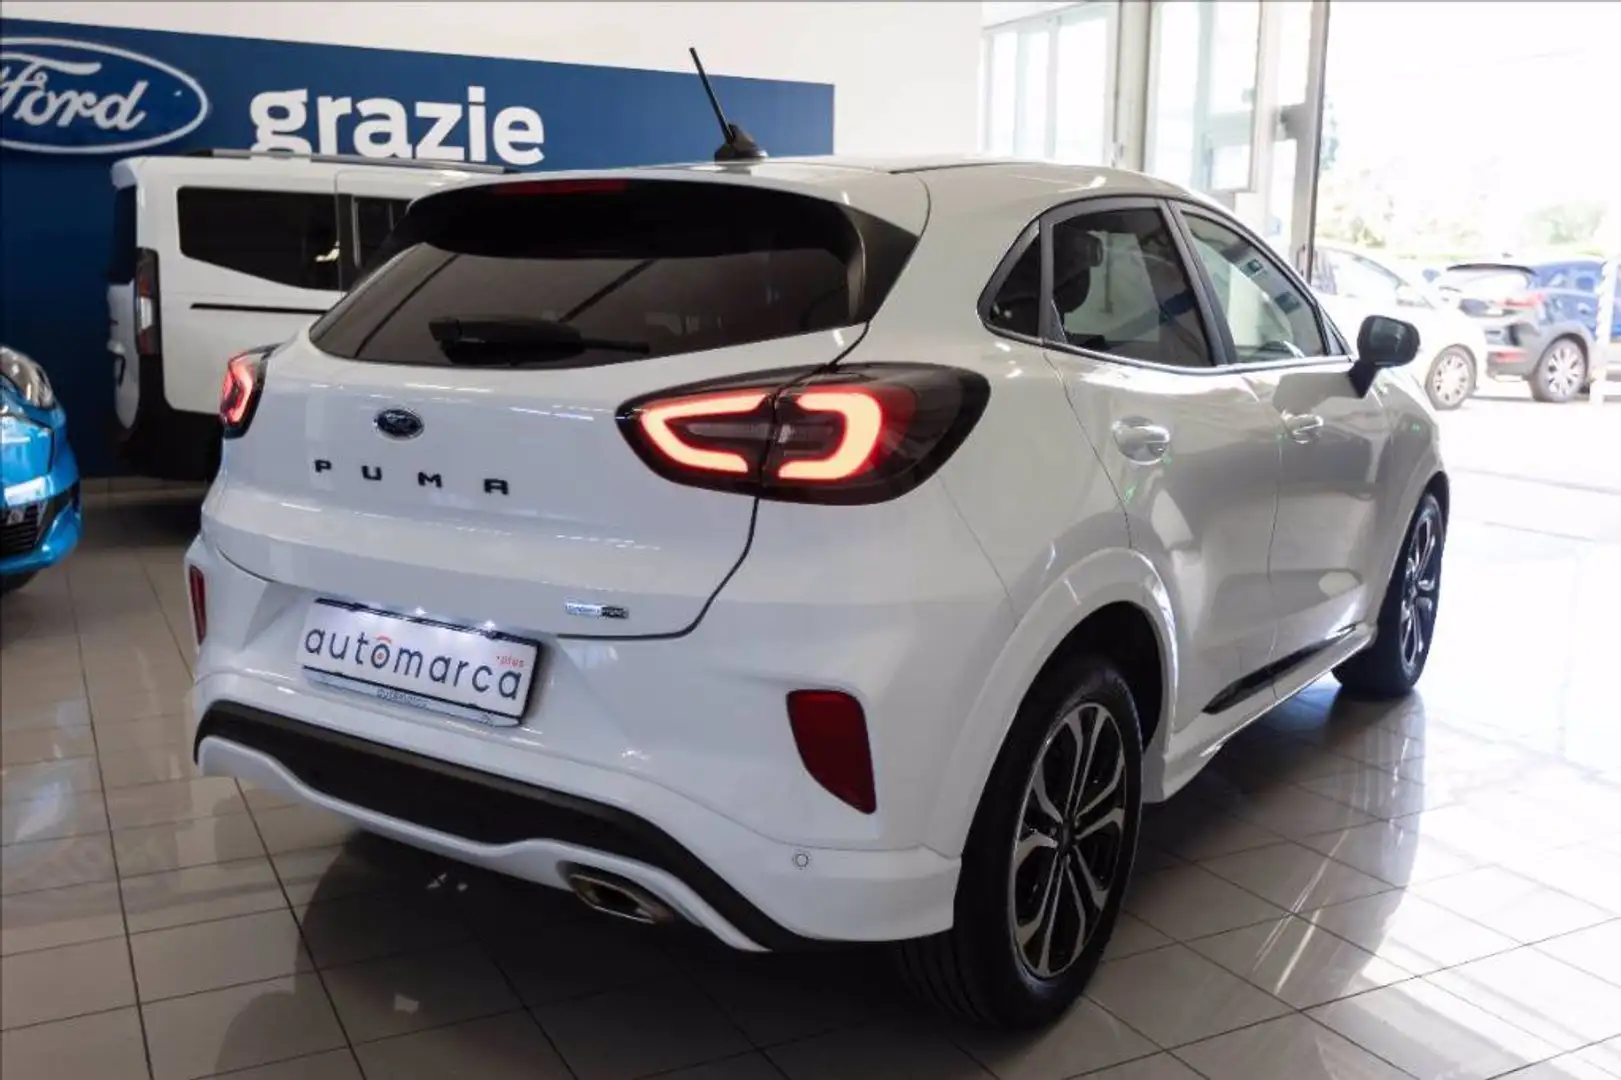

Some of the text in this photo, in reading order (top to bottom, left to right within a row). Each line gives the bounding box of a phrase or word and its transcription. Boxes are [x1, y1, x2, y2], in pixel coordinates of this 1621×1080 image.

[0, 51, 150, 131] Ford
[249, 86, 545, 165] grazie
[313, 459, 510, 495] PUMA
